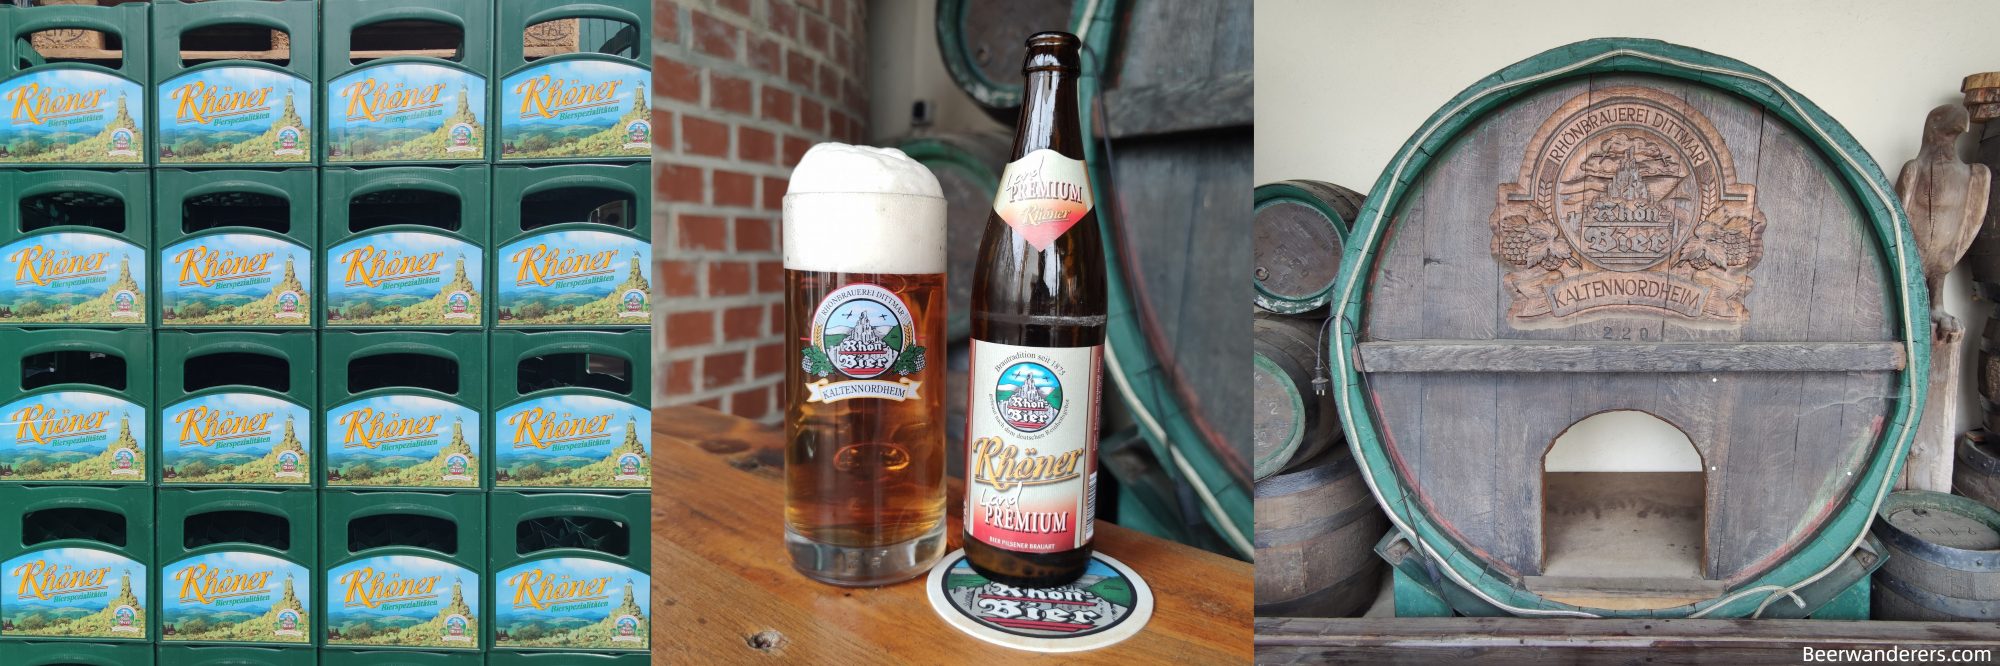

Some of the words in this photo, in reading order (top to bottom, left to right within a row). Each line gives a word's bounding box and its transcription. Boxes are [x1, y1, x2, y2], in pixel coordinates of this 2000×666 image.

[7, 82, 107, 125] Rhöner
[171, 81, 273, 125] Rhöner
[342, 78, 446, 122] Rhöner
[515, 75, 623, 119] Rhöner
[48, 114, 104, 127] Bierspezialitäten
[213, 112, 270, 126] Bierspezialitäten
[384, 108, 443, 124] Bierspezialitäten
[559, 105, 619, 120] Bierspezialitäten
[1550, 107, 1649, 162] RHÖNBRAUEREI
[1652, 112, 1707, 165] DITTMAR
[1010, 181, 1082, 204] PREMIUM
[1584, 226, 1669, 253] Bier
[11, 245, 110, 287] Rhöner
[175, 245, 274, 287] Rhöner
[341, 245, 444, 288] Rhöner
[512, 244, 619, 287] Rhöner
[51, 276, 107, 289] Bierspezialitäten
[215, 277, 271, 289] Bierspezialitäten
[382, 276, 440, 290] Bierspezialitäten
[555, 274, 615, 289] Bierspezialitäten
[1552, 278, 1702, 310] KALTENNORDHEIM
[876, 291, 905, 315] DITTMAR
[840, 354, 888, 368] Bier
[995, 350, 1036, 373] Brautradition
[822, 384, 906, 400] KALTENNORDHEIM
[12, 404, 110, 445] Rhöner
[175, 405, 274, 447] Rhöner
[340, 407, 441, 449] Rhöner
[509, 407, 614, 449] Rhöner
[1008, 408, 1048, 423] Bier
[52, 434, 107, 447] Bierspezialitäten
[215, 436, 271, 449] Bierspezialitäten
[381, 439, 438, 451] Bierspezialitäten
[552, 438, 611, 451] Bierspezialitäten
[973, 436, 1084, 491] Rhöner
[984, 503, 1068, 534] PREMIUM
[14, 560, 111, 600] Rhöner
[175, 563, 273, 604] Rhöner
[340, 567, 441, 609] Rhöner
[509, 569, 612, 610] Rhöner
[53, 590, 108, 603] Bierspezialitäten
[215, 594, 271, 607] Bierspezialitäten
[381, 599, 438, 612] Bierspezialitäten
[551, 601, 609, 613] Bierspezialitäten
[978, 598, 1102, 624] Bier
